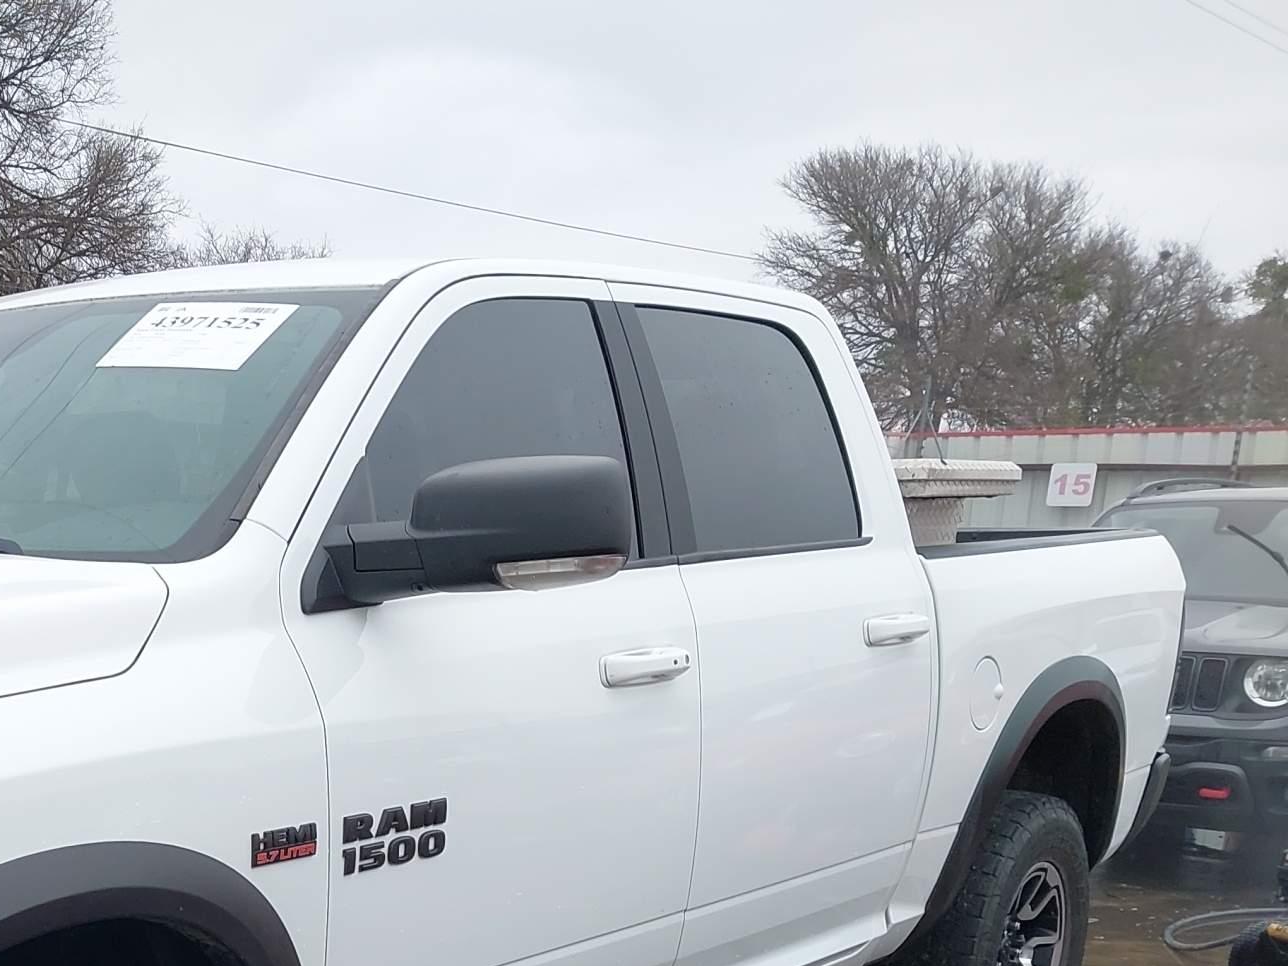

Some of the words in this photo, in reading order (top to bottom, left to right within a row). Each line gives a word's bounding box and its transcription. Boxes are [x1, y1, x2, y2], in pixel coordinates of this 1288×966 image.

[151, 316, 266, 330] 43971525
[1054, 473, 1092, 496] 15
[342, 798, 448, 845] RAM
[251, 822, 318, 850] HEMI
[256, 850, 279, 865] 5.7
[279, 843, 316, 861] LITER
[342, 829, 447, 876] 1500
